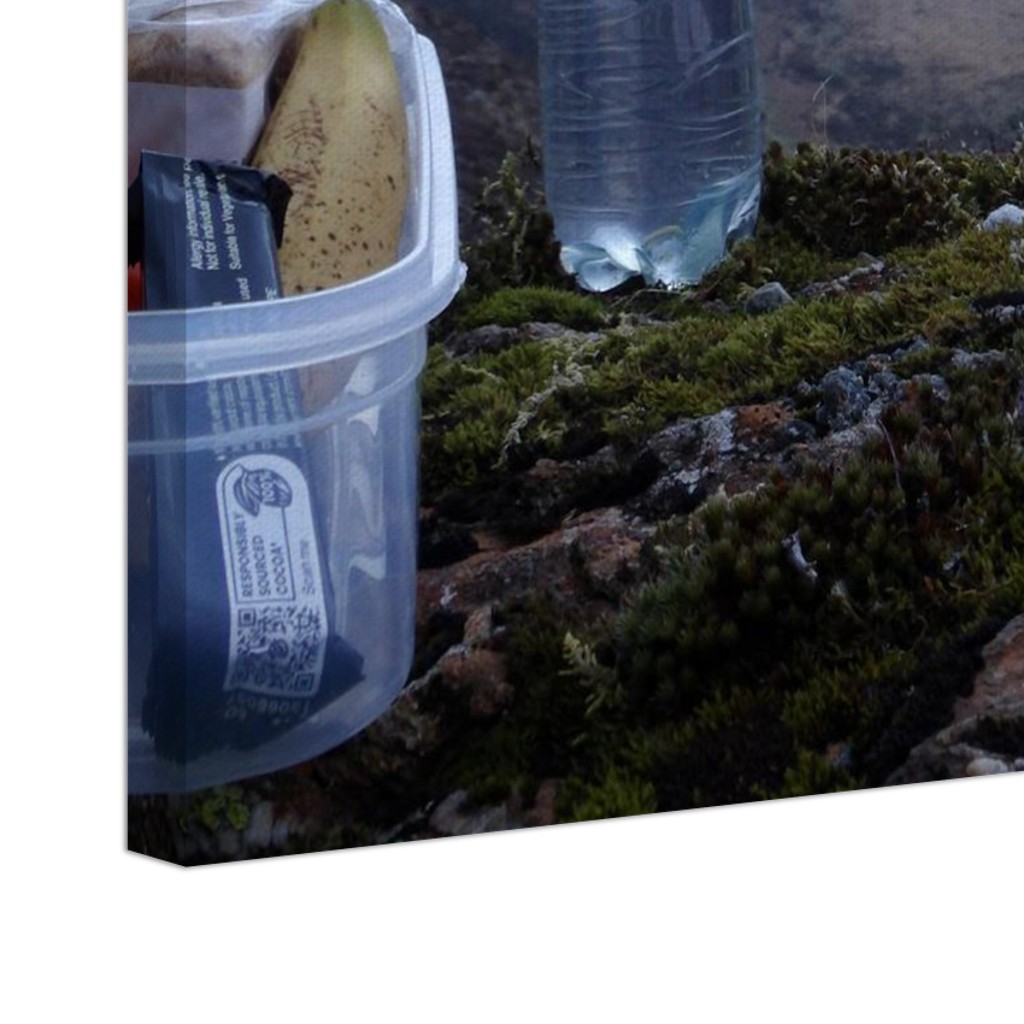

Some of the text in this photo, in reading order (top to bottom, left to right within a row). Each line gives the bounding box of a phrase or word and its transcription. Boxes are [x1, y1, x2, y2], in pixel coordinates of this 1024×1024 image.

[223, 222, 236, 235] for
[190, 239, 204, 270] Allergy
[204, 240, 216, 253] for
[226, 235, 242, 271] Suitable
[207, 254, 220, 271] Not
[237, 277, 251, 301] used
[232, 512, 253, 597] RESPONSIBLY
[252, 534, 271, 596] SOURCED
[300, 561, 316, 596] Scan
